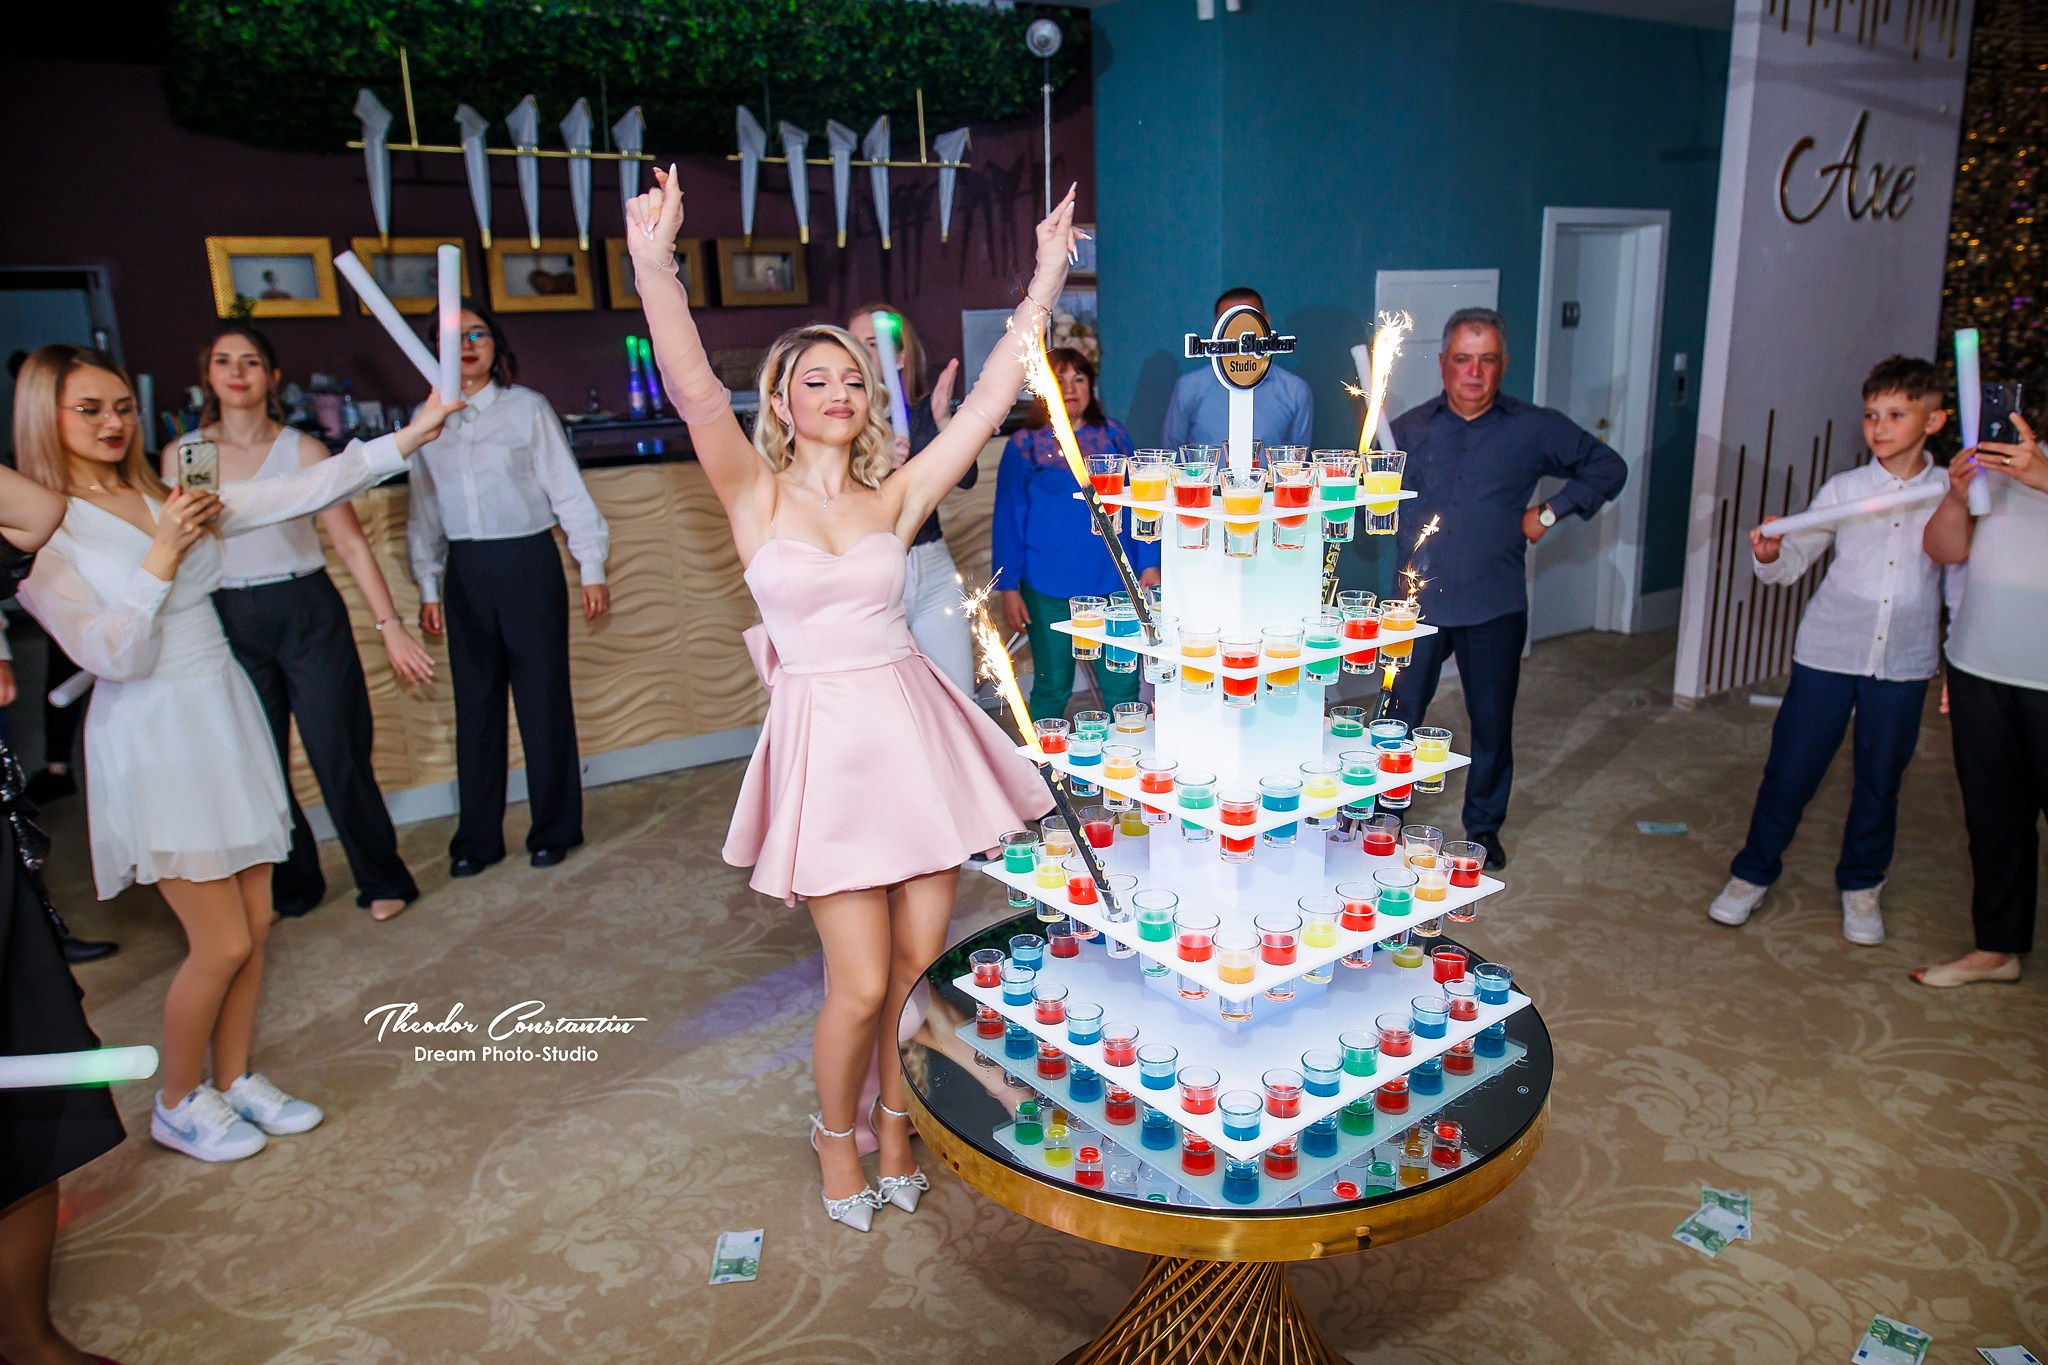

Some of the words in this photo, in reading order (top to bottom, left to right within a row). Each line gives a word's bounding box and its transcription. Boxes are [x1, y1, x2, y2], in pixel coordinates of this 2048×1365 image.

[1780, 109, 1917, 224] Axe
[1186, 335, 1239, 357] Dream
[1230, 360, 1257, 373] Studio
